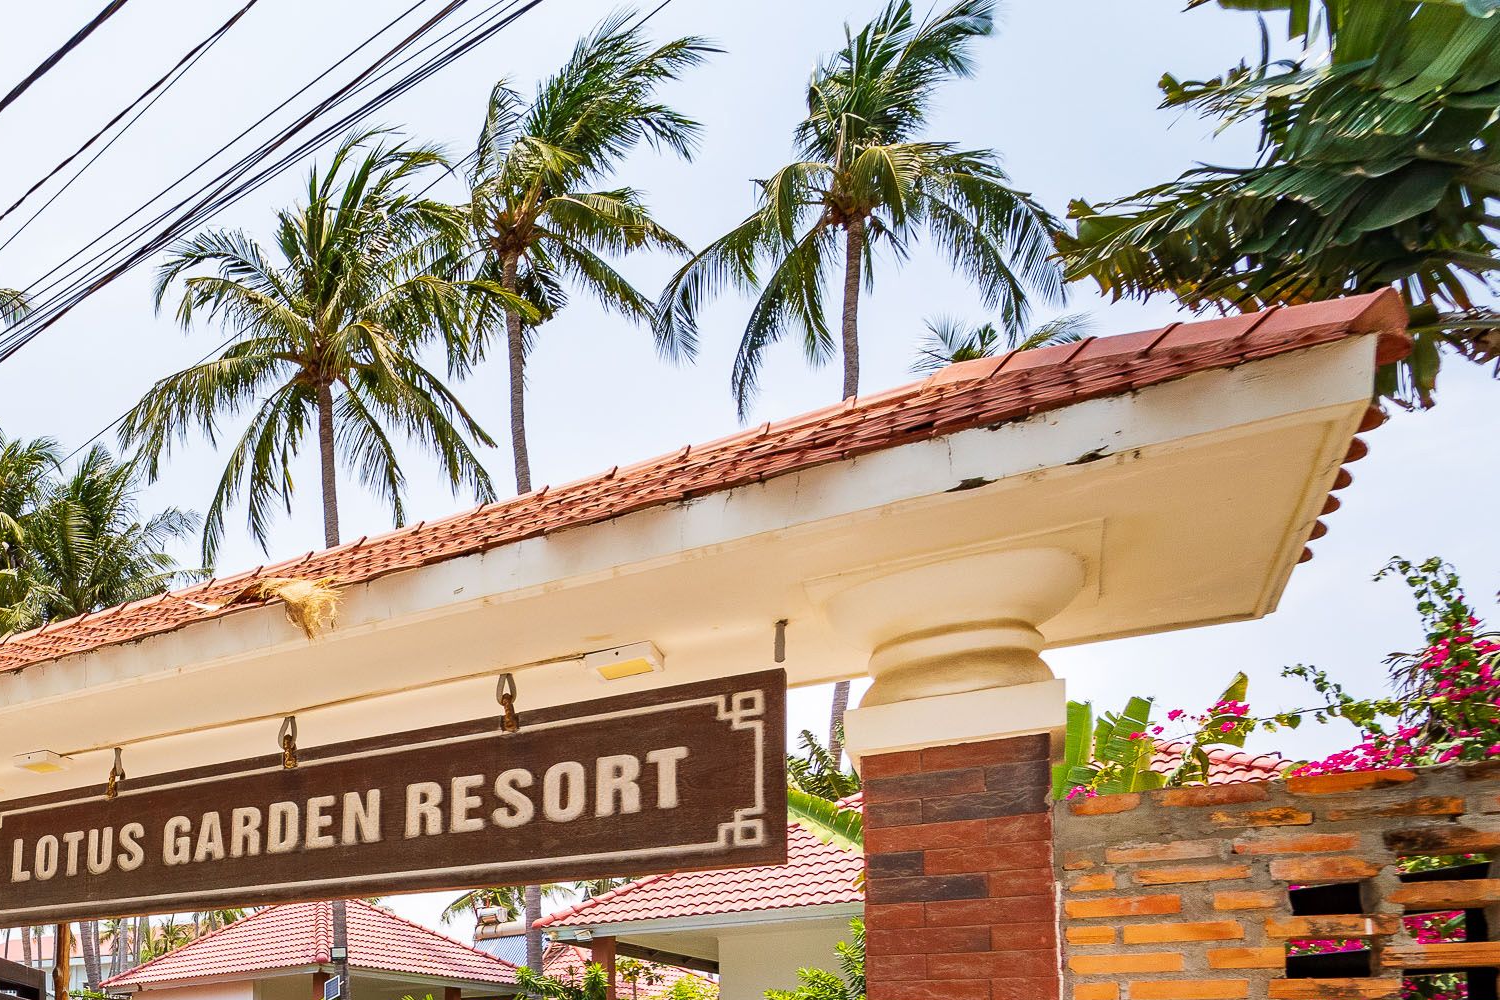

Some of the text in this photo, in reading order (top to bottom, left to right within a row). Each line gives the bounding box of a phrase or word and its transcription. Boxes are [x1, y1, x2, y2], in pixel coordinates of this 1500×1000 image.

[12, 746, 689, 883] LOTUS GARDEN RESORT
